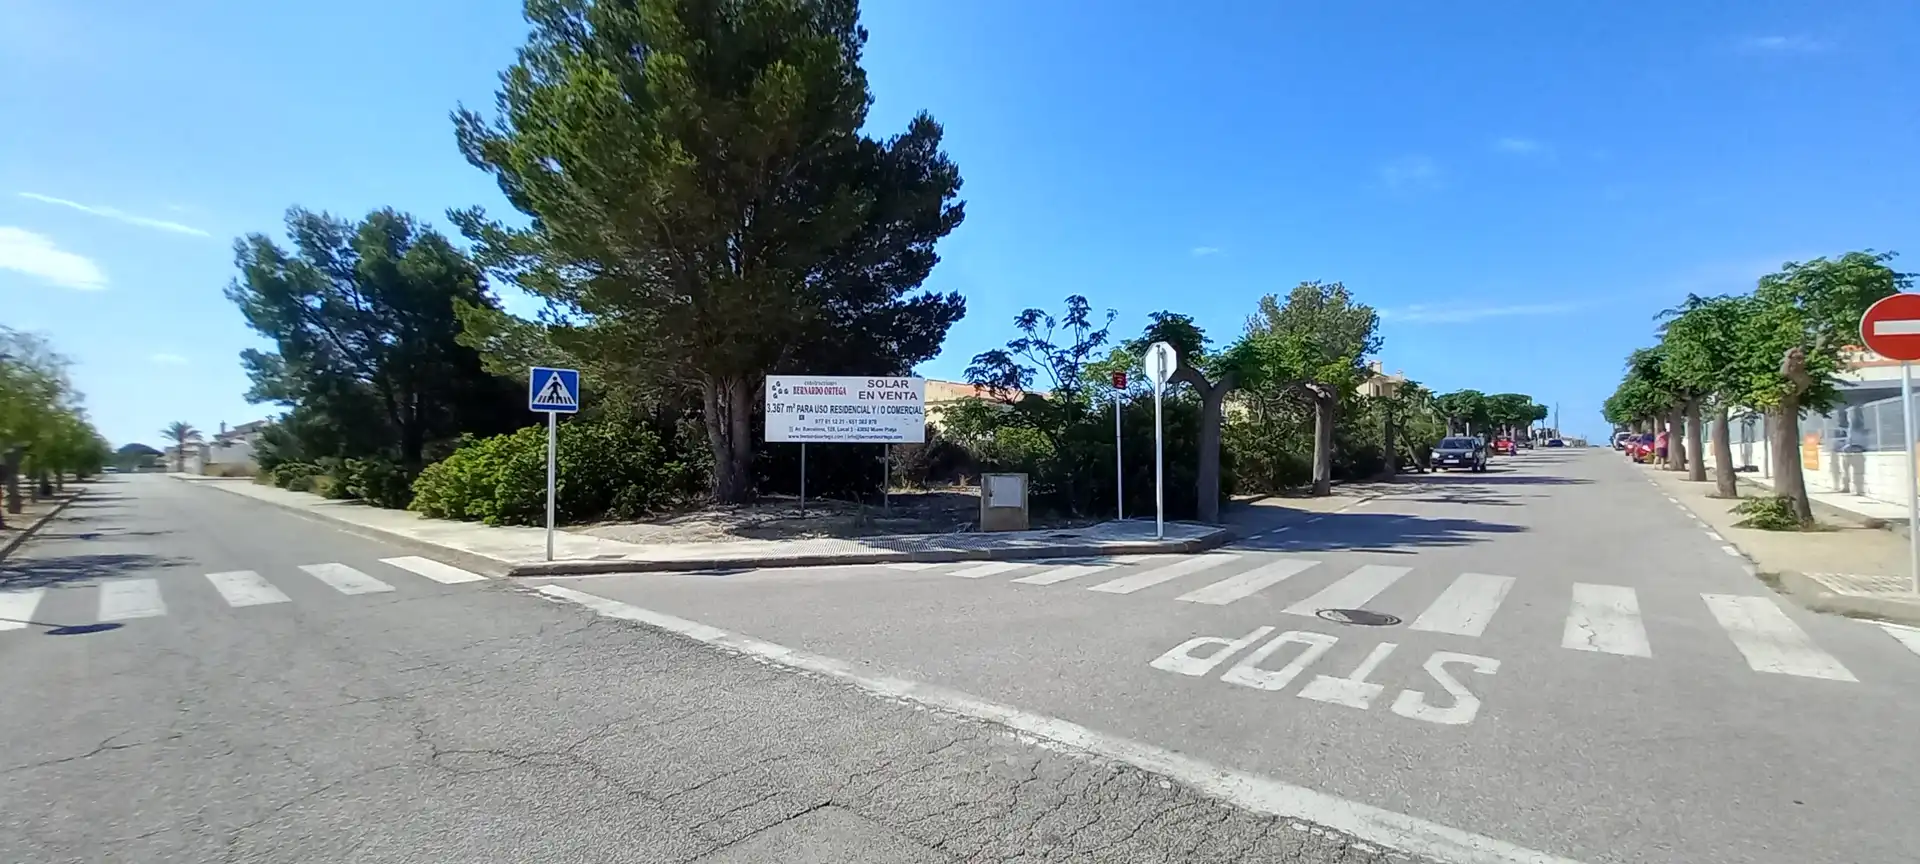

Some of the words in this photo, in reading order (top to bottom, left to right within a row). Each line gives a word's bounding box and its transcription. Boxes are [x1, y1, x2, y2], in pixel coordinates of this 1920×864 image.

[867, 379, 909, 389] SOLAR
[793, 386, 824, 396] BERNARDO
[824, 386, 847, 396] ORTEGA
[858, 391, 875, 400] EN
[877, 392, 918, 401] VENTA
[797, 404, 813, 414] PARA
[815, 405, 828, 414] USO
[830, 405, 870, 414] RESIDENCIAL
[871, 406, 876, 414] Y
[886, 406, 923, 415] COMERCIAL
[1149, 625, 1501, 725] STOP
